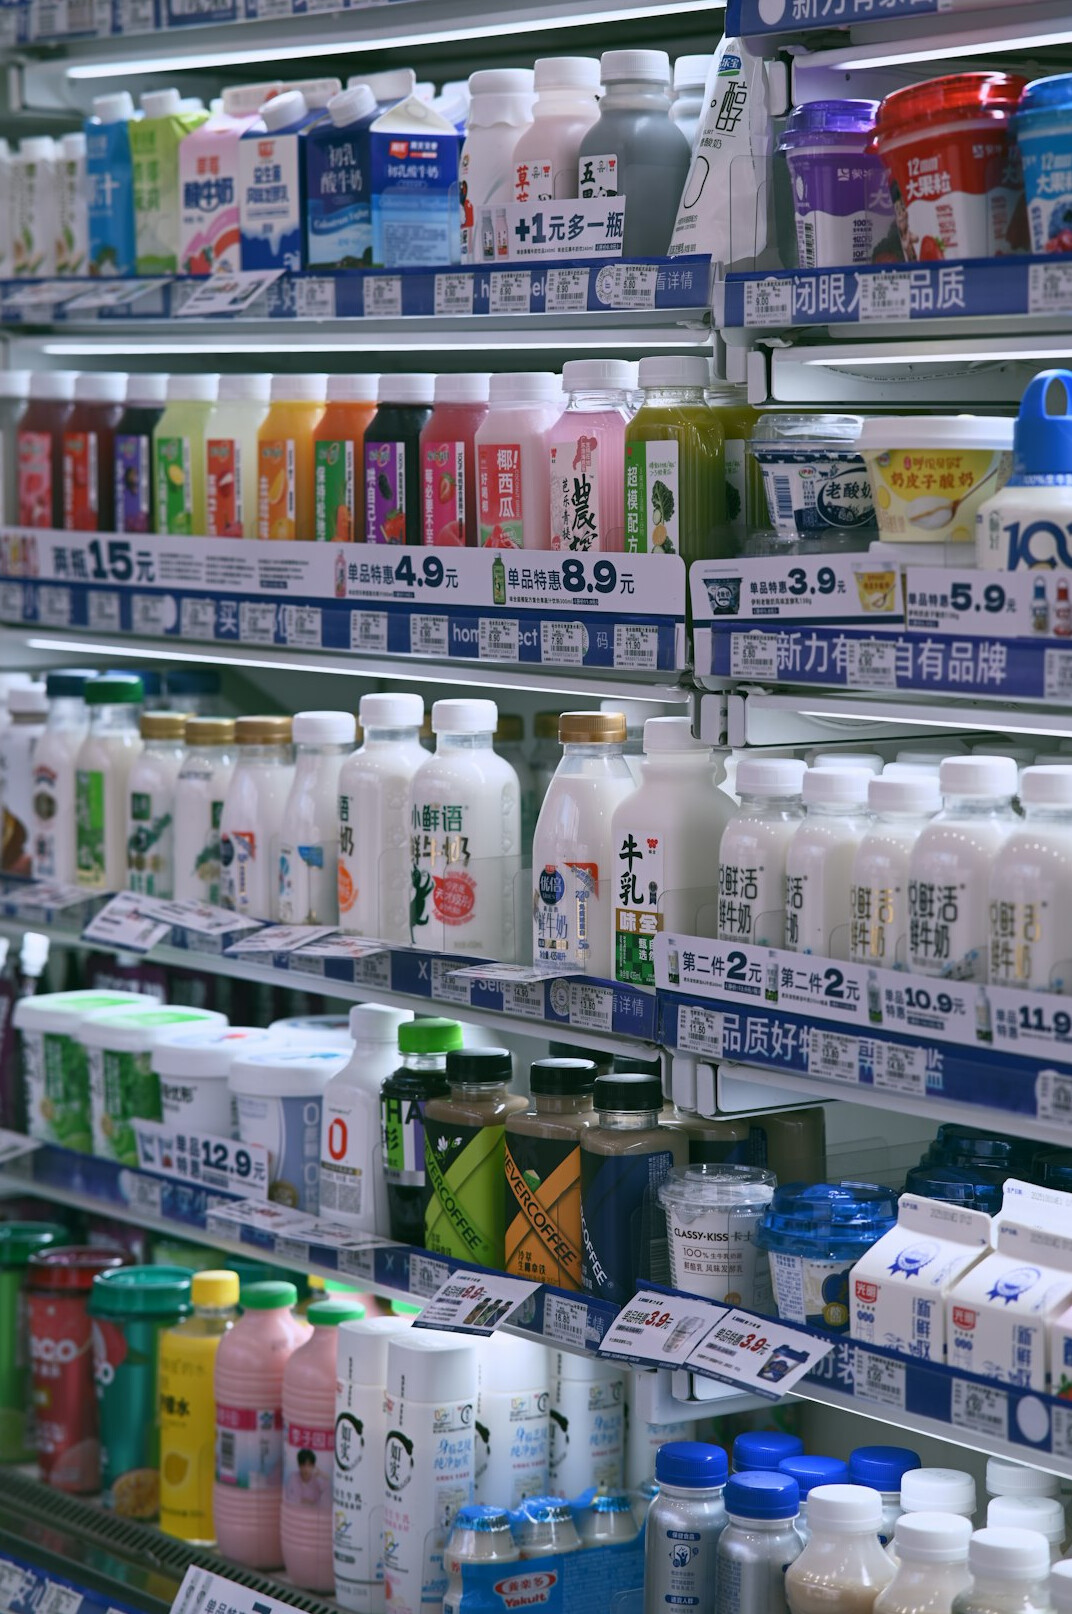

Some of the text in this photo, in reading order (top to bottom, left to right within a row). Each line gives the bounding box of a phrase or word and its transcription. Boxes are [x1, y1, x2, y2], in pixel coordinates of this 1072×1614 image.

[905, 170, 952, 201] 大果粒
[515, 211, 624, 244] +1元多一瓶
[890, 470, 975, 490] 奶皮子酸奶
[627, 465, 639, 554] 超模配方
[347, 555, 459, 589] 单品特惠4.9元
[507, 558, 635, 595] 单品特惠8.9元
[750, 566, 847, 595] 单品特惠3.9元
[908, 582, 1018, 614] 单品特惠5.9元
[776, 631, 1008, 685] 新力有自有品牌
[412, 803, 463, 832] 小鲜语
[618, 833, 645, 907] 牛乳
[619, 911, 659, 934] 味全
[682, 950, 763, 984] 第二件2元
[780, 967, 860, 1001] 第二件2元
[905, 987, 967, 1015] 10.9元
[202, 1140, 265, 1181] 12.9元
[856, 1280, 877, 1298] 光明
[291, 1426, 335, 1447] 李子园
[505, 1593, 547, 1609] Yakult
